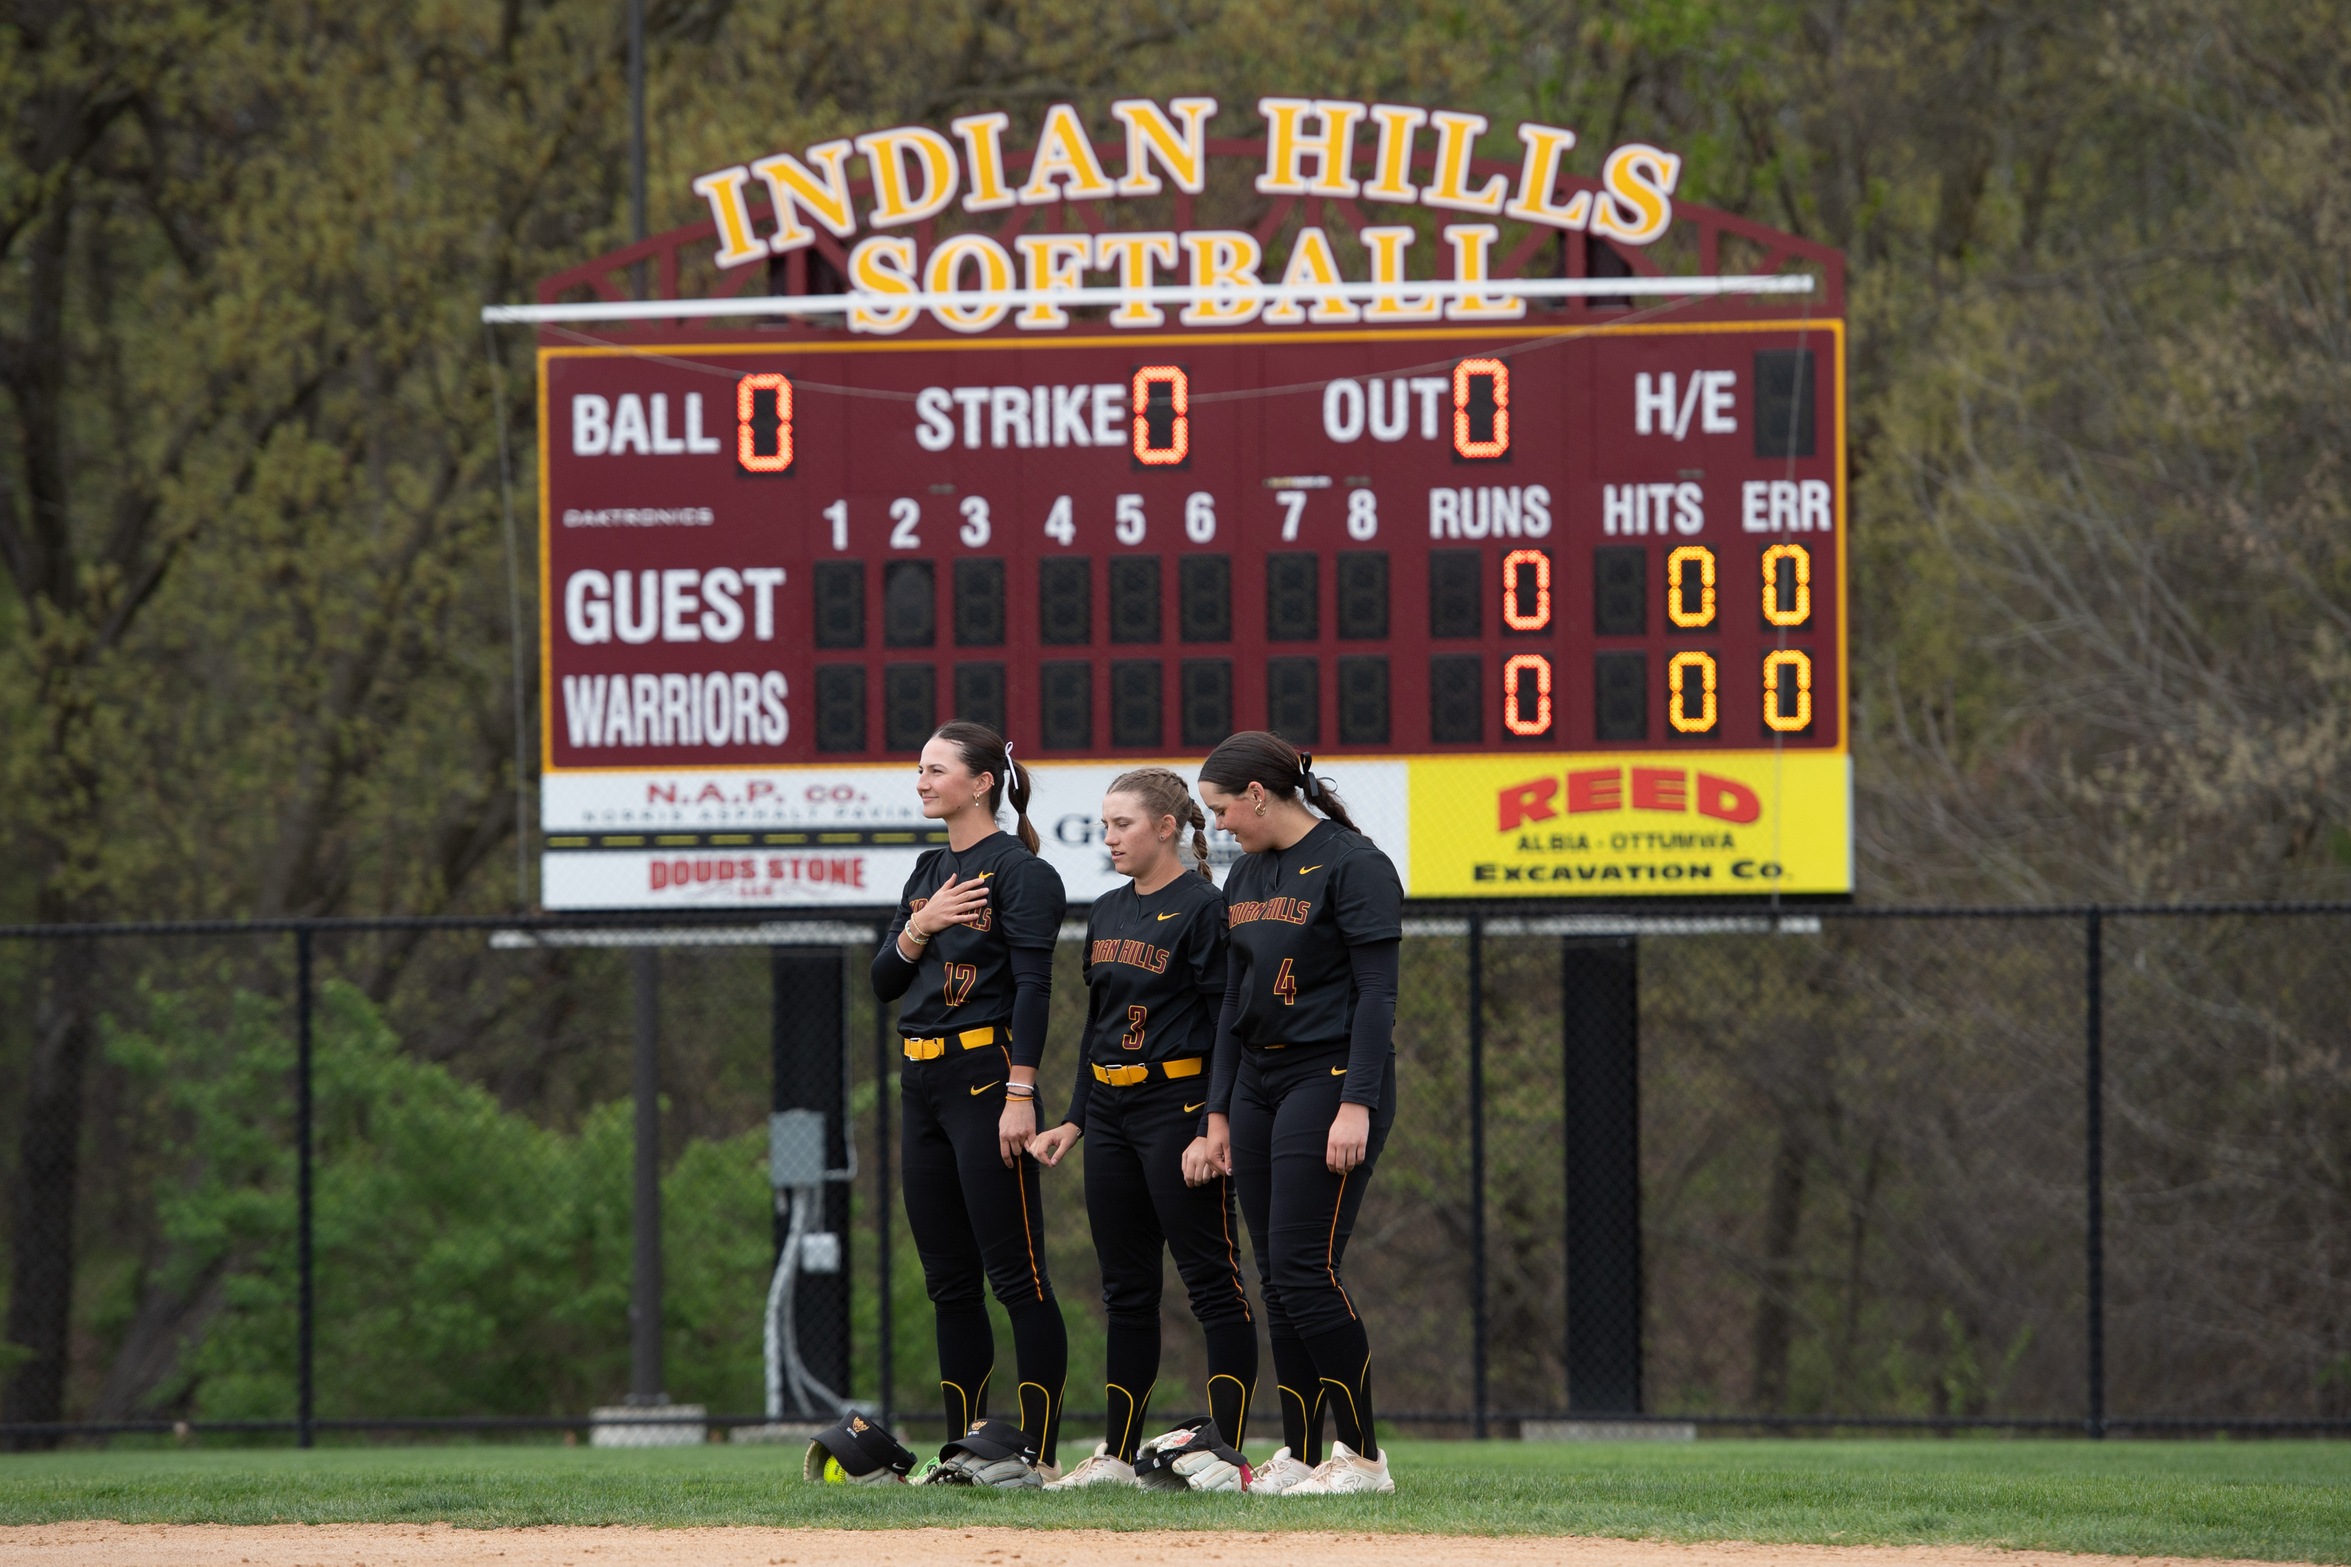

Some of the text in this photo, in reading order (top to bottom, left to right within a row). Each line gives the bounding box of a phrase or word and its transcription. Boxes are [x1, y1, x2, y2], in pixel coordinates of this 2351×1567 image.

[693, 97, 1682, 270] INDIAN HILLS
[846, 223, 1527, 334] SOFTBALL
[572, 373, 794, 472] BALL 0
[915, 365, 1189, 465] STRIKE 0
[1322, 358, 1510, 458] OUT 0
[1634, 369, 1738, 441] H/E
[823, 479, 1832, 551] 1 2 3 4 5 6 7 8 RUNS HITS ERR
[564, 544, 1811, 645] GUEST 0 0 0
[562, 649, 1812, 748] WARRIORS 0 0 0
[647, 780, 784, 804] N.A.P.
[1498, 766, 1762, 832] REED
[651, 857, 867, 890] DOUDS STONE
[1518, 833, 1590, 851] ALBIA
[1611, 832, 1735, 850] OTTUMWA
[1262, 896, 1312, 926] HILLS
[943, 961, 977, 1007] 12
[1118, 939, 1170, 974] HILLS
[1273, 958, 1297, 1006] 4
[1121, 1004, 1148, 1050] 3
